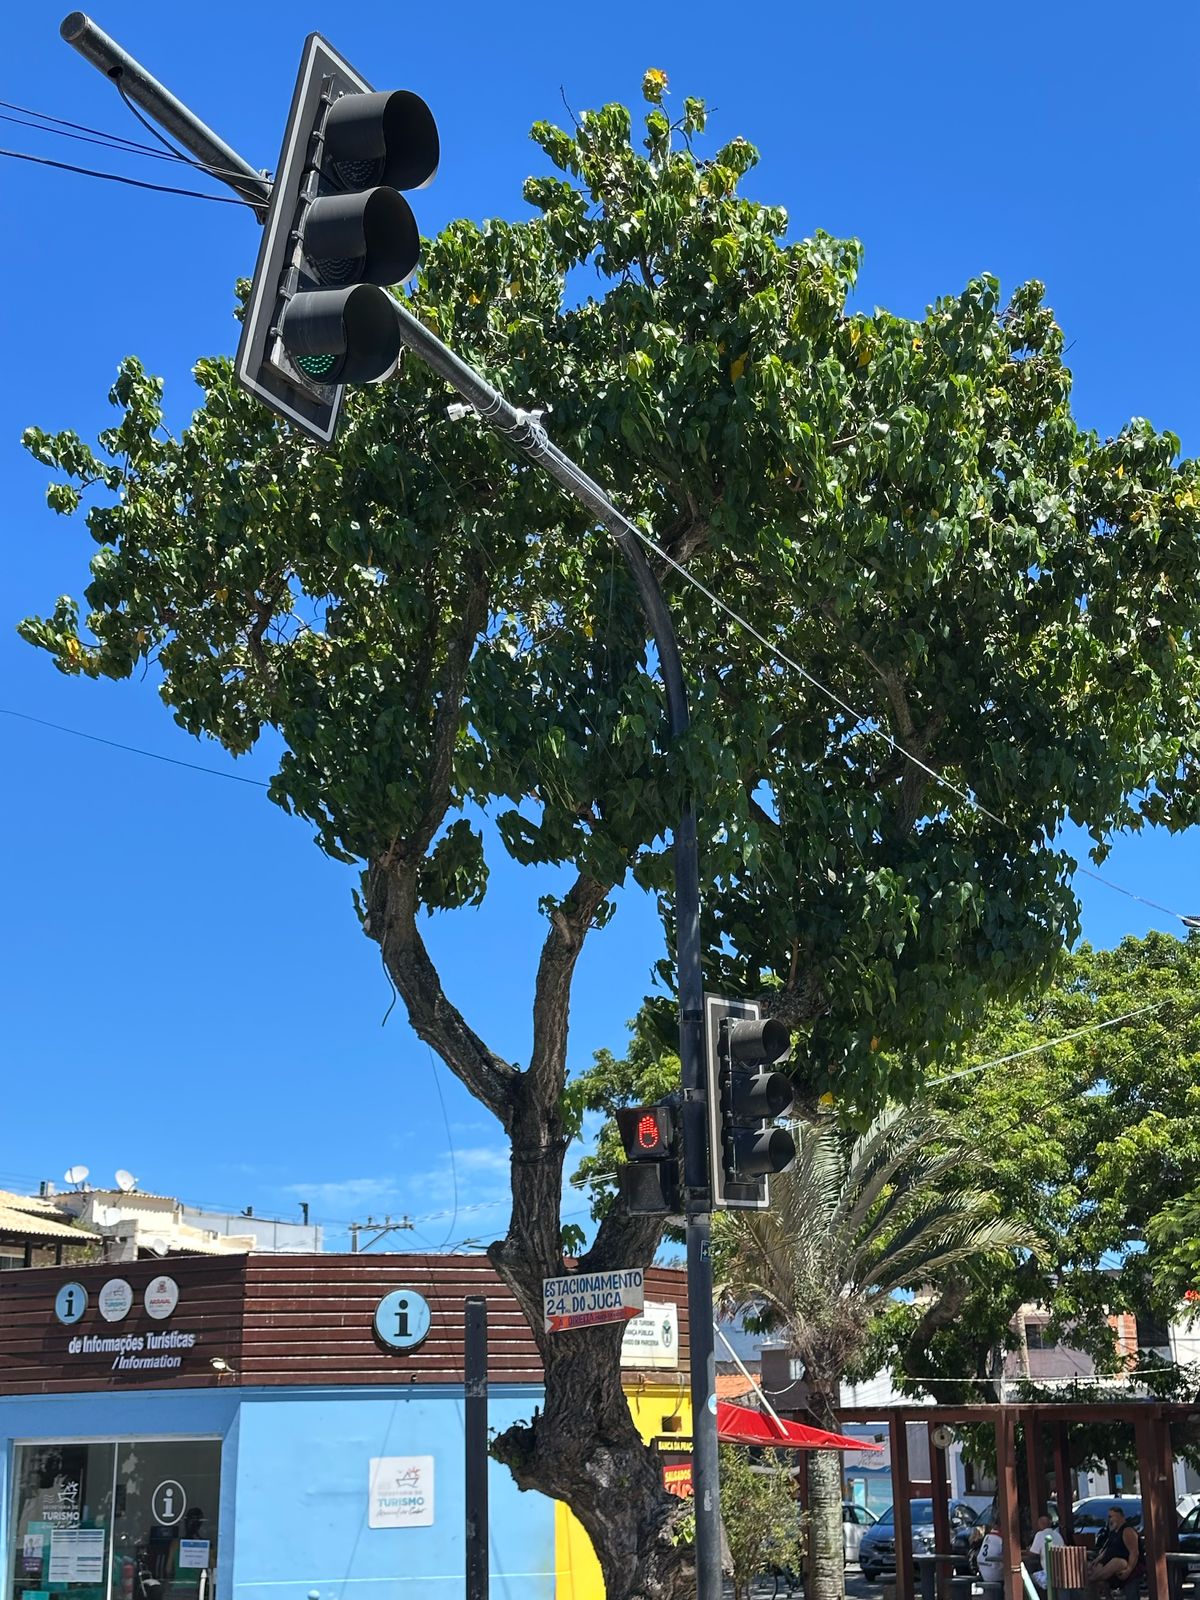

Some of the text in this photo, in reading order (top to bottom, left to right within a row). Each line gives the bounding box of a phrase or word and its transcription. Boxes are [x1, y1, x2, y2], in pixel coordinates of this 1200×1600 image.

[545, 1272, 642, 1297] ESTACIONAMENTO
[572, 1296, 586, 1312] DO
[587, 1292, 622, 1311] JUCA
[568, 1312, 594, 1328] DIREITA
[69, 1331, 195, 1355] de Informações Turísticas
[118, 1354, 182, 1369] Information
[680, 1441, 694, 1454] PRAÇ
[664, 1469, 691, 1483] SALGADOS
[377, 1497, 424, 1507] TURISMO
[42, 1511, 80, 1521] TURISMO
[982, 1543, 989, 1557] 3
